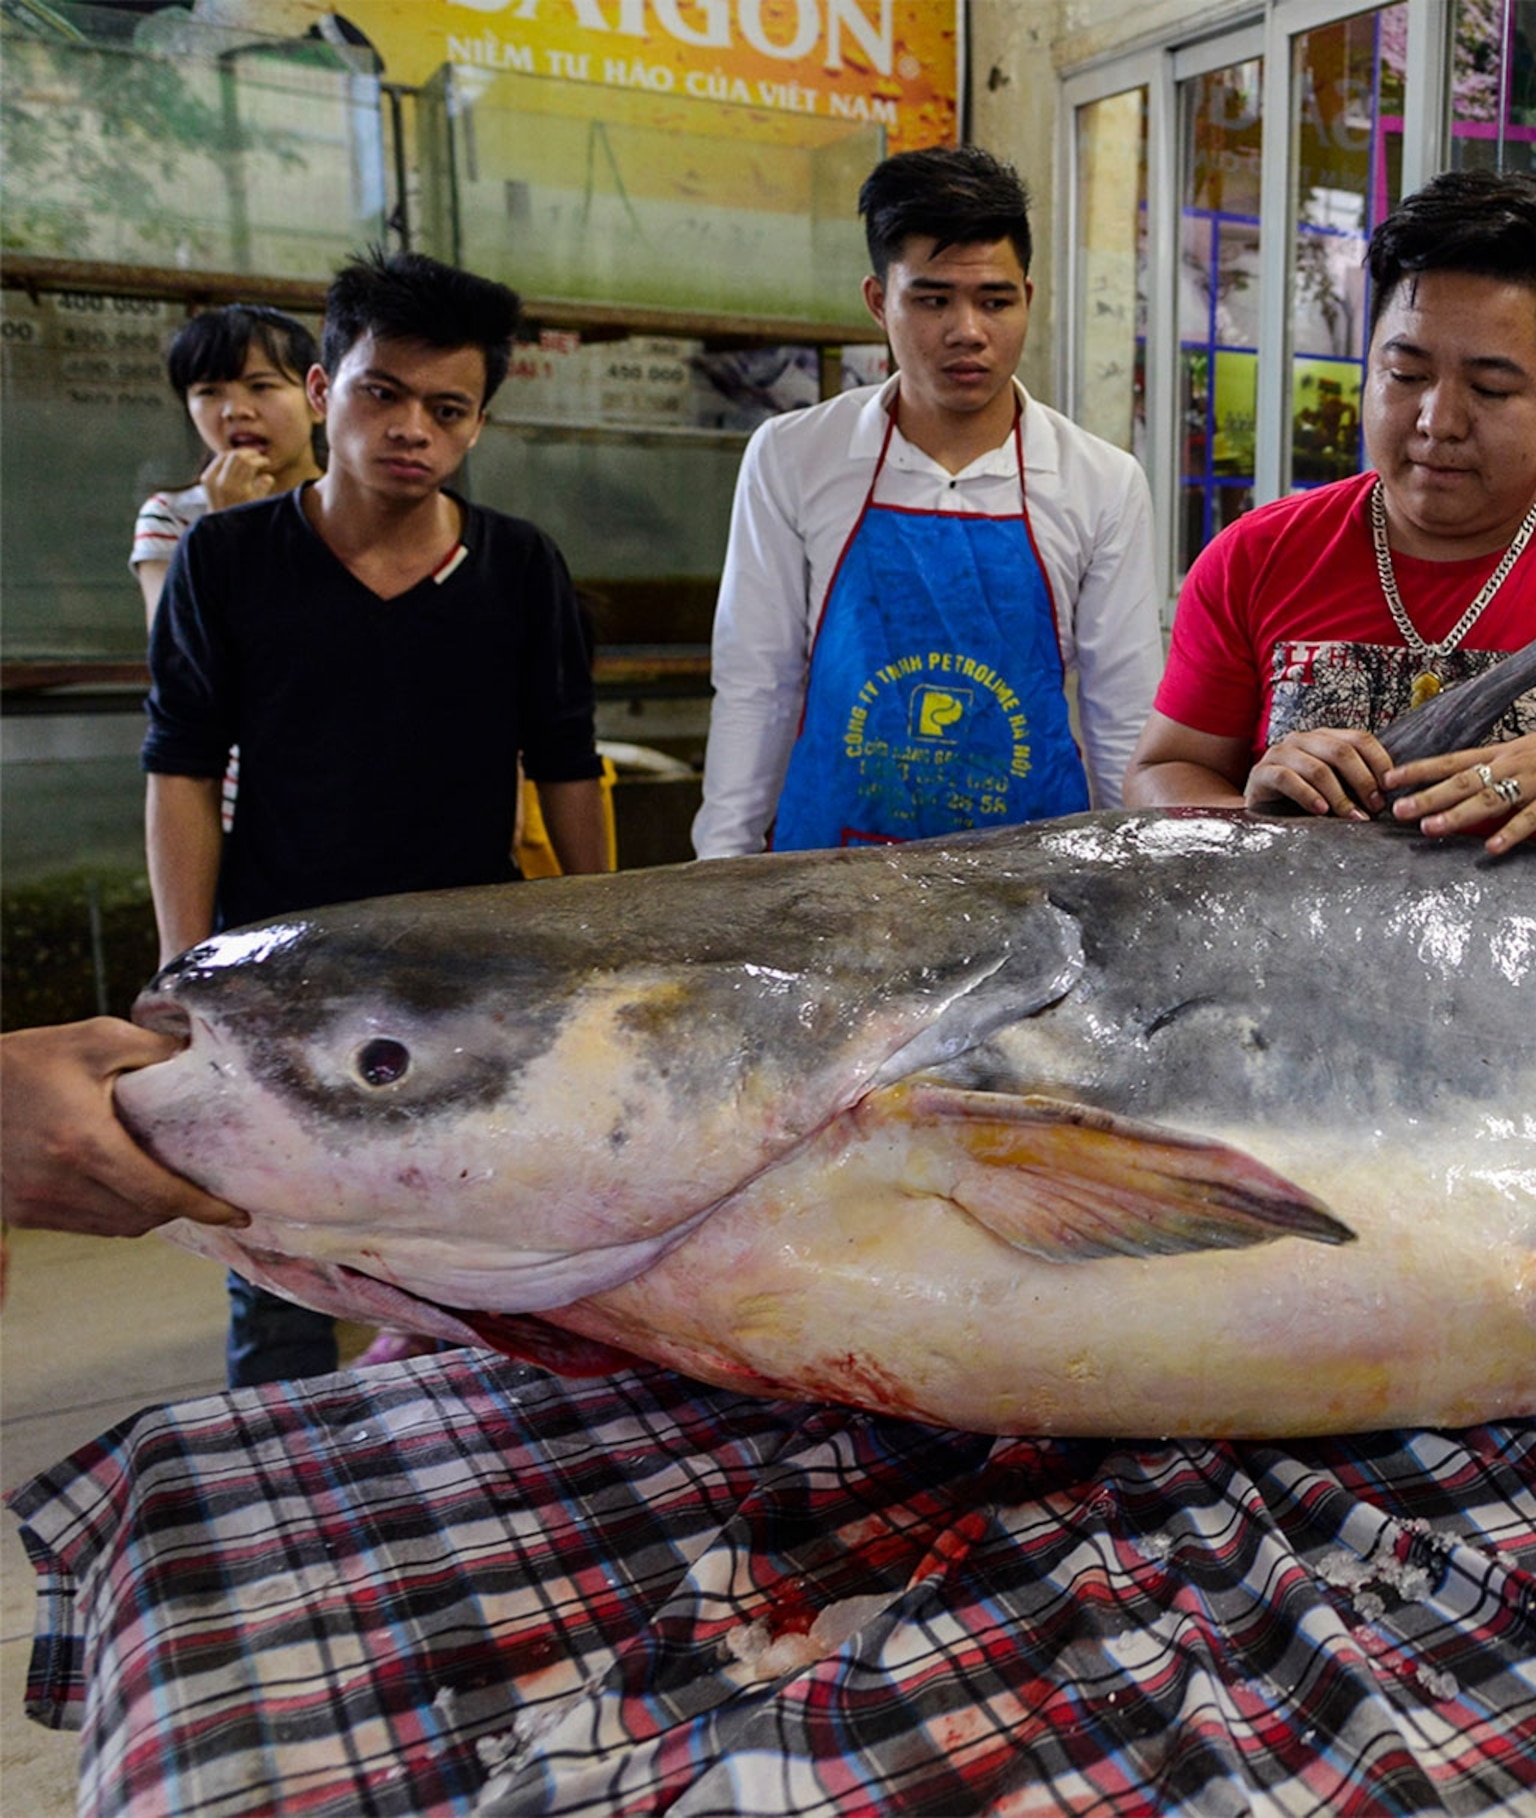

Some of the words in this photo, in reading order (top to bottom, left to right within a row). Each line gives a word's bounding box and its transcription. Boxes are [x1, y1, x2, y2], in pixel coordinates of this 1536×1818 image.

[829, 93, 898, 125] NAM
[648, 365, 684, 383] 000
[858, 680, 879, 704] TY
